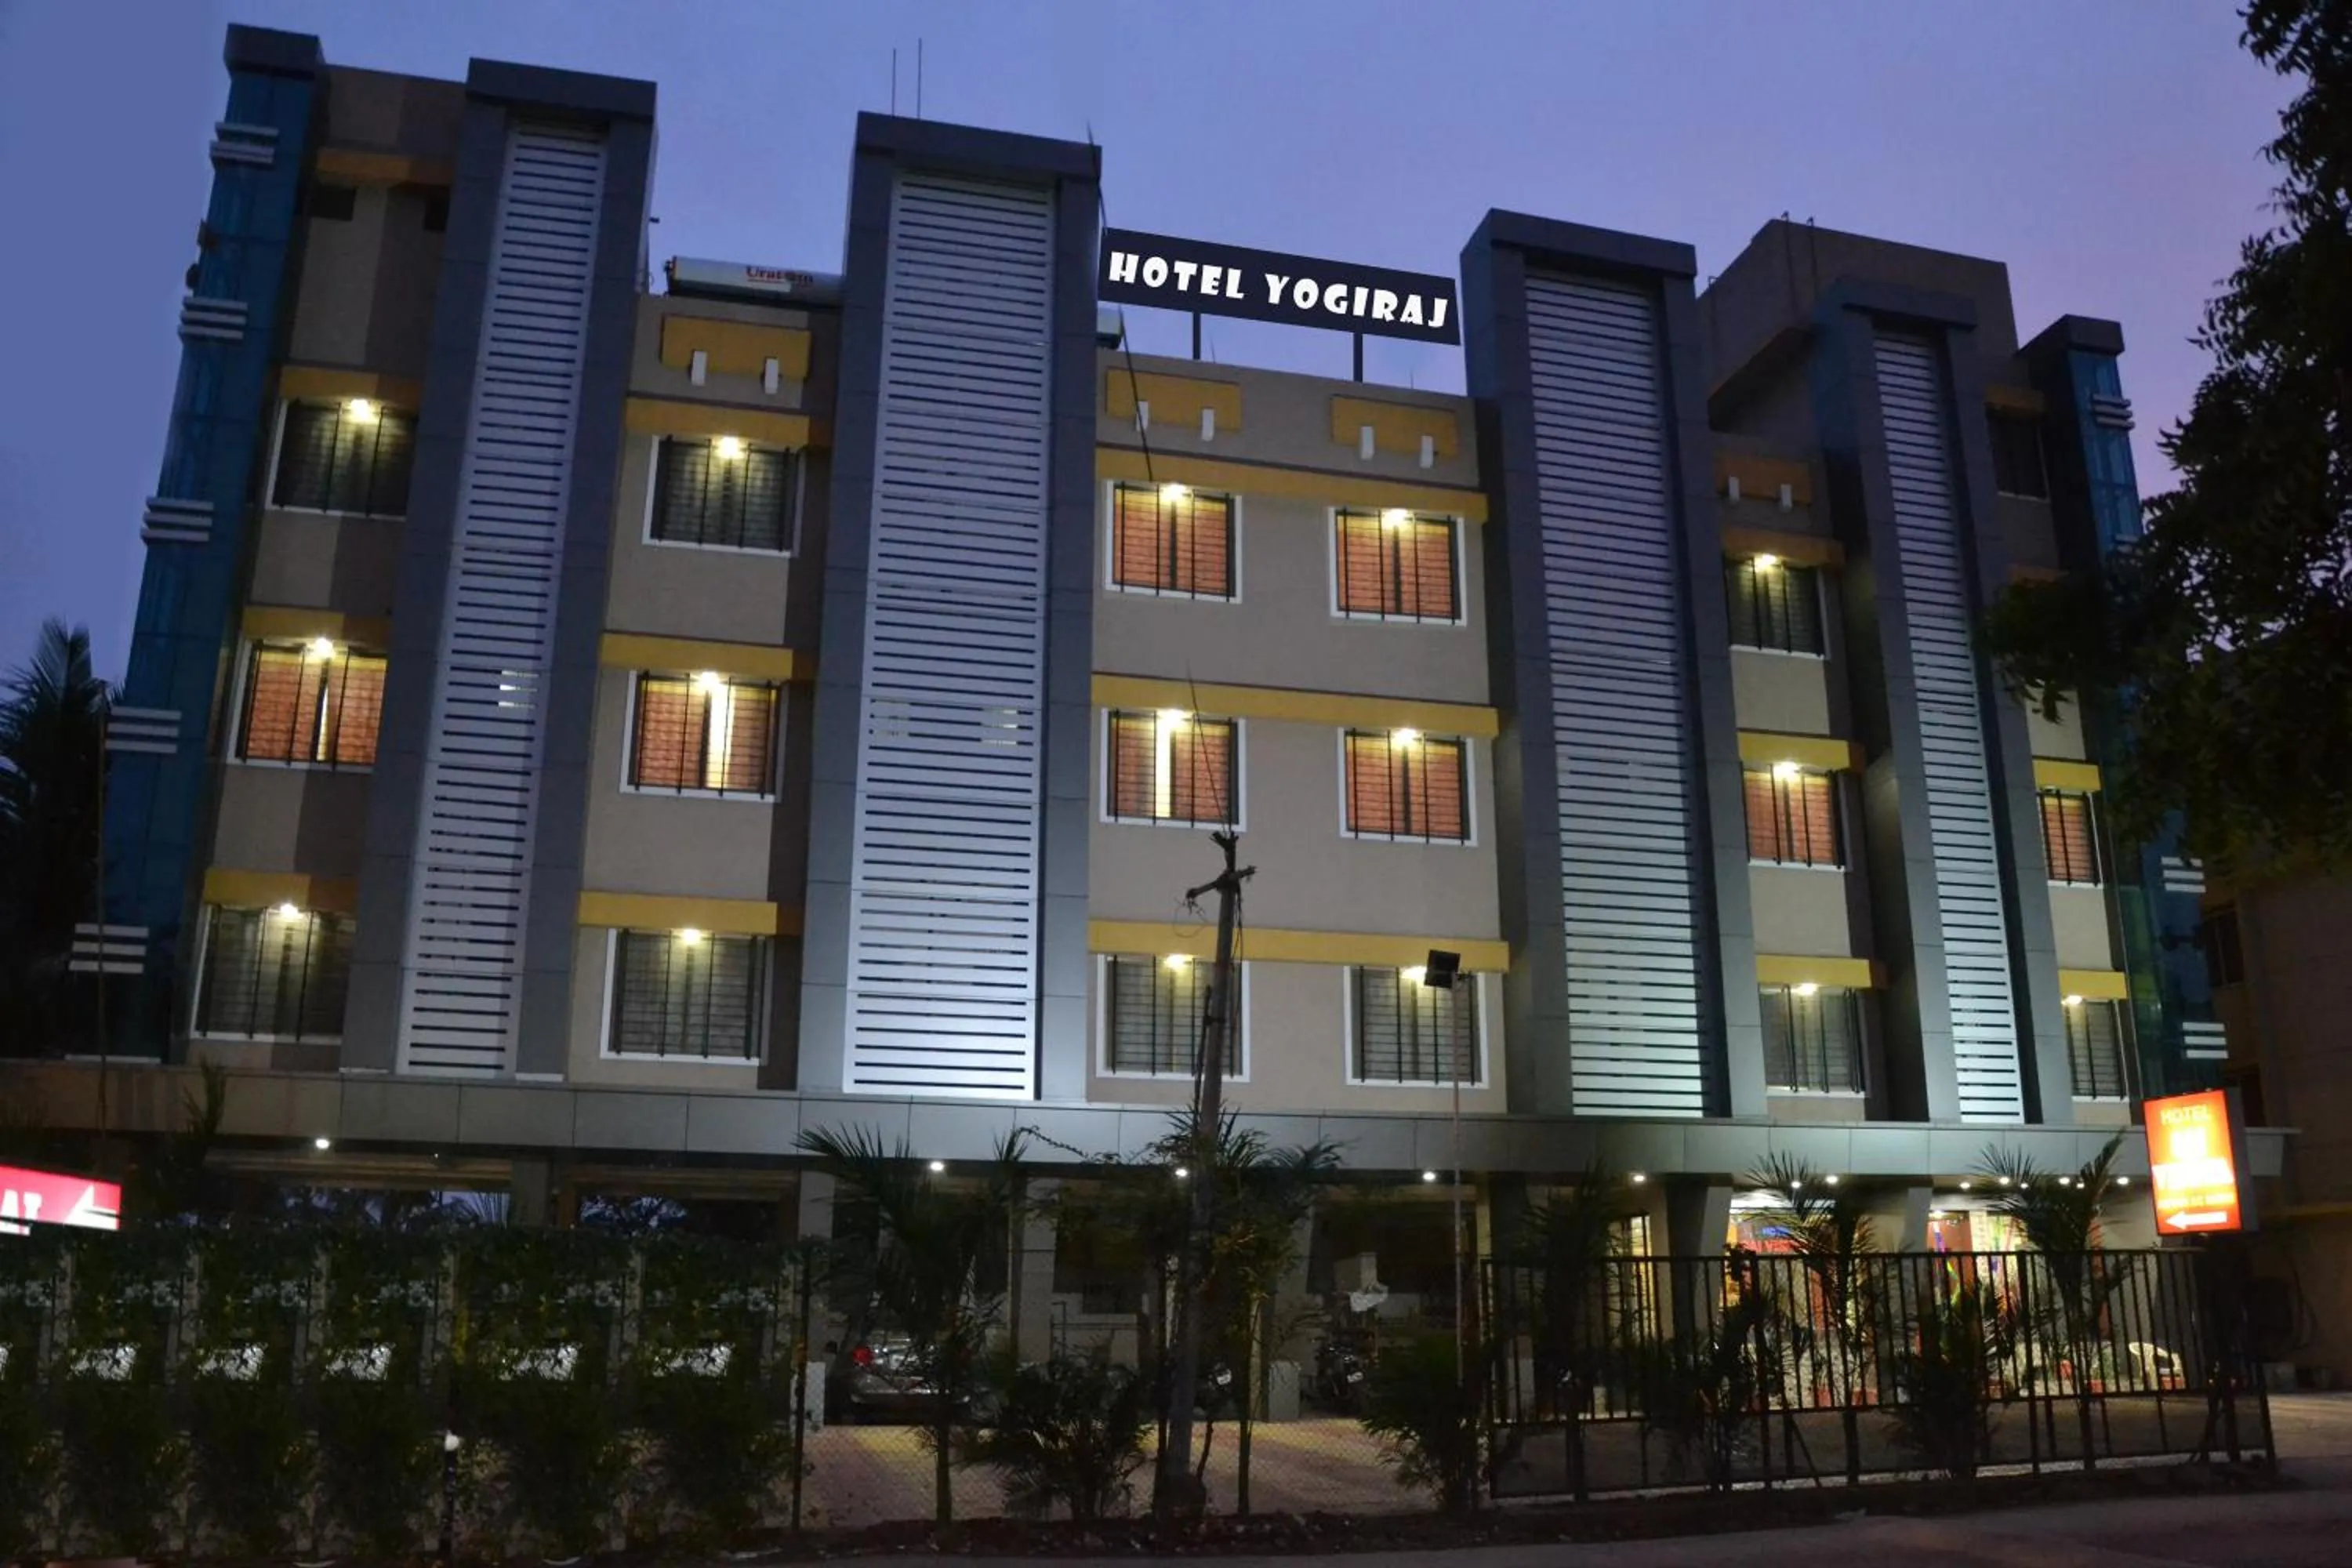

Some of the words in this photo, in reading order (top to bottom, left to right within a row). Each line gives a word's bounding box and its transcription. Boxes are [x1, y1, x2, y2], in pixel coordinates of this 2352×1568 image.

[1109, 252, 1244, 299] HOTEL
[1265, 274, 1448, 328] YOGIRAJ
[2160, 1104, 2212, 1127] HOTEL
